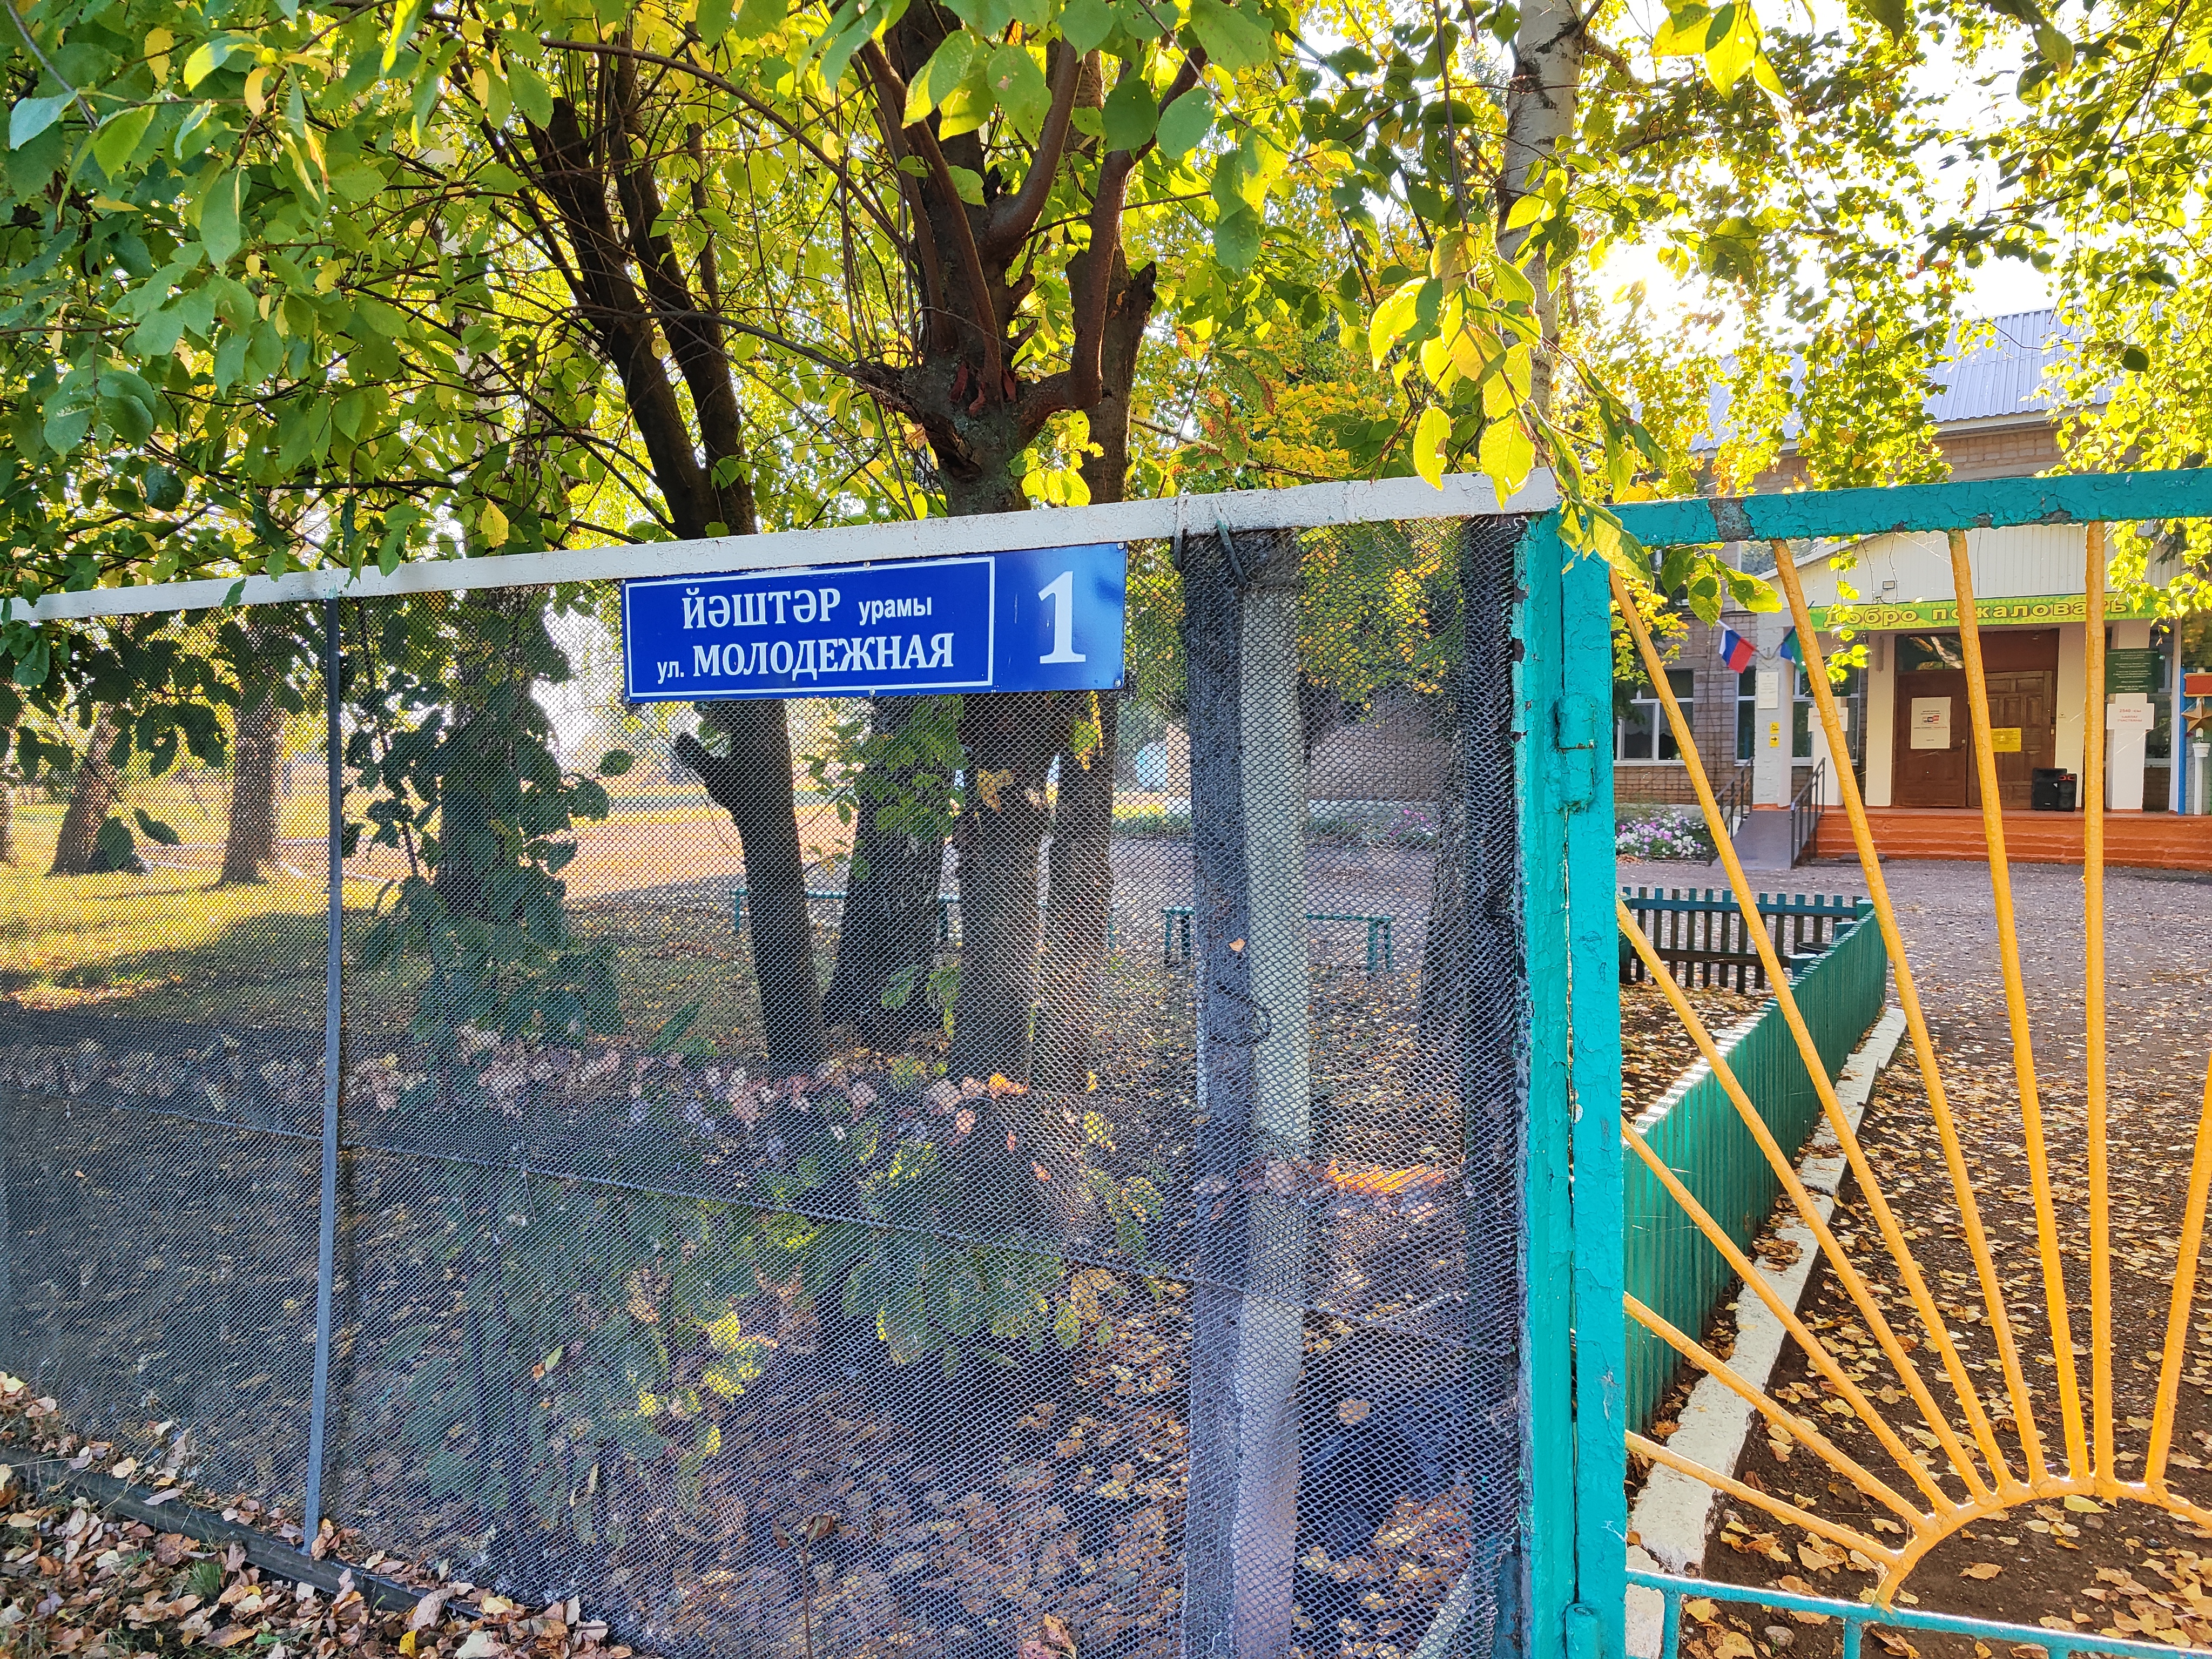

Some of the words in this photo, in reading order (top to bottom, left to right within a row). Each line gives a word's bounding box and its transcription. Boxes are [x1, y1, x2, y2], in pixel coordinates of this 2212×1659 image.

[682, 587, 840, 629] ЙӘШТӘР
[858, 597, 932, 626] урамы
[1038, 570, 1087, 664] 1
[1932, 600, 2127, 620] пжаловаь
[657, 661, 685, 684] ул.
[692, 632, 954, 681] МОЛОДЕЖНАЯ
